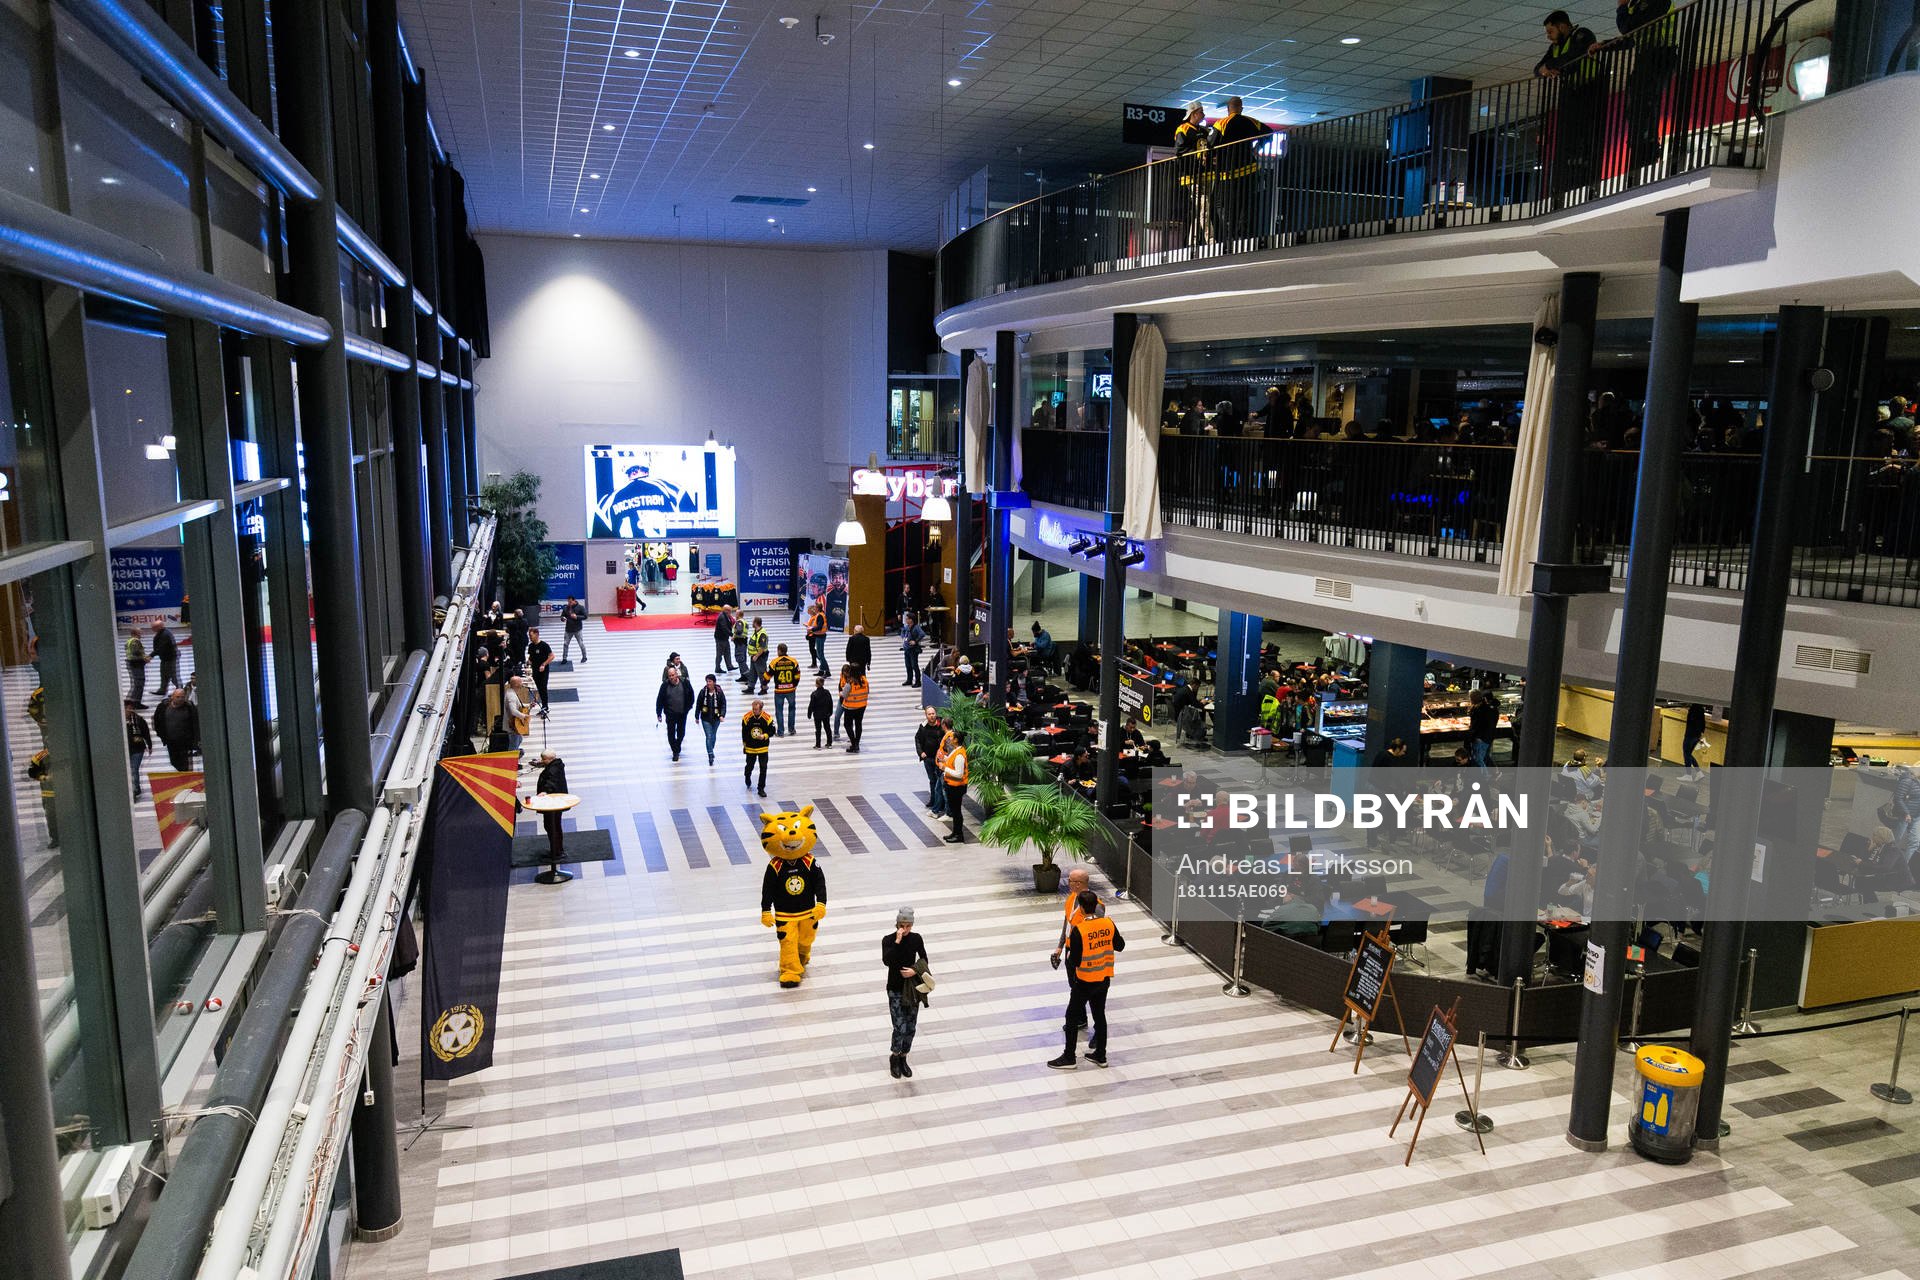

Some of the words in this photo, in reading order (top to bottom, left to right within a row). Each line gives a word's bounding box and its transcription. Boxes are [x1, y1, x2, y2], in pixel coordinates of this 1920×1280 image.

[1126, 107, 1166, 123] R3-Q3
[852, 468, 959, 501] Sybar
[751, 547, 760, 555] VI
[762, 547, 790, 555] SATSA
[748, 566, 760, 577] PÅ
[778, 671, 792, 683] 40
[1087, 928, 1111, 941] 50/50
[450, 1004, 467, 1014] 1912
